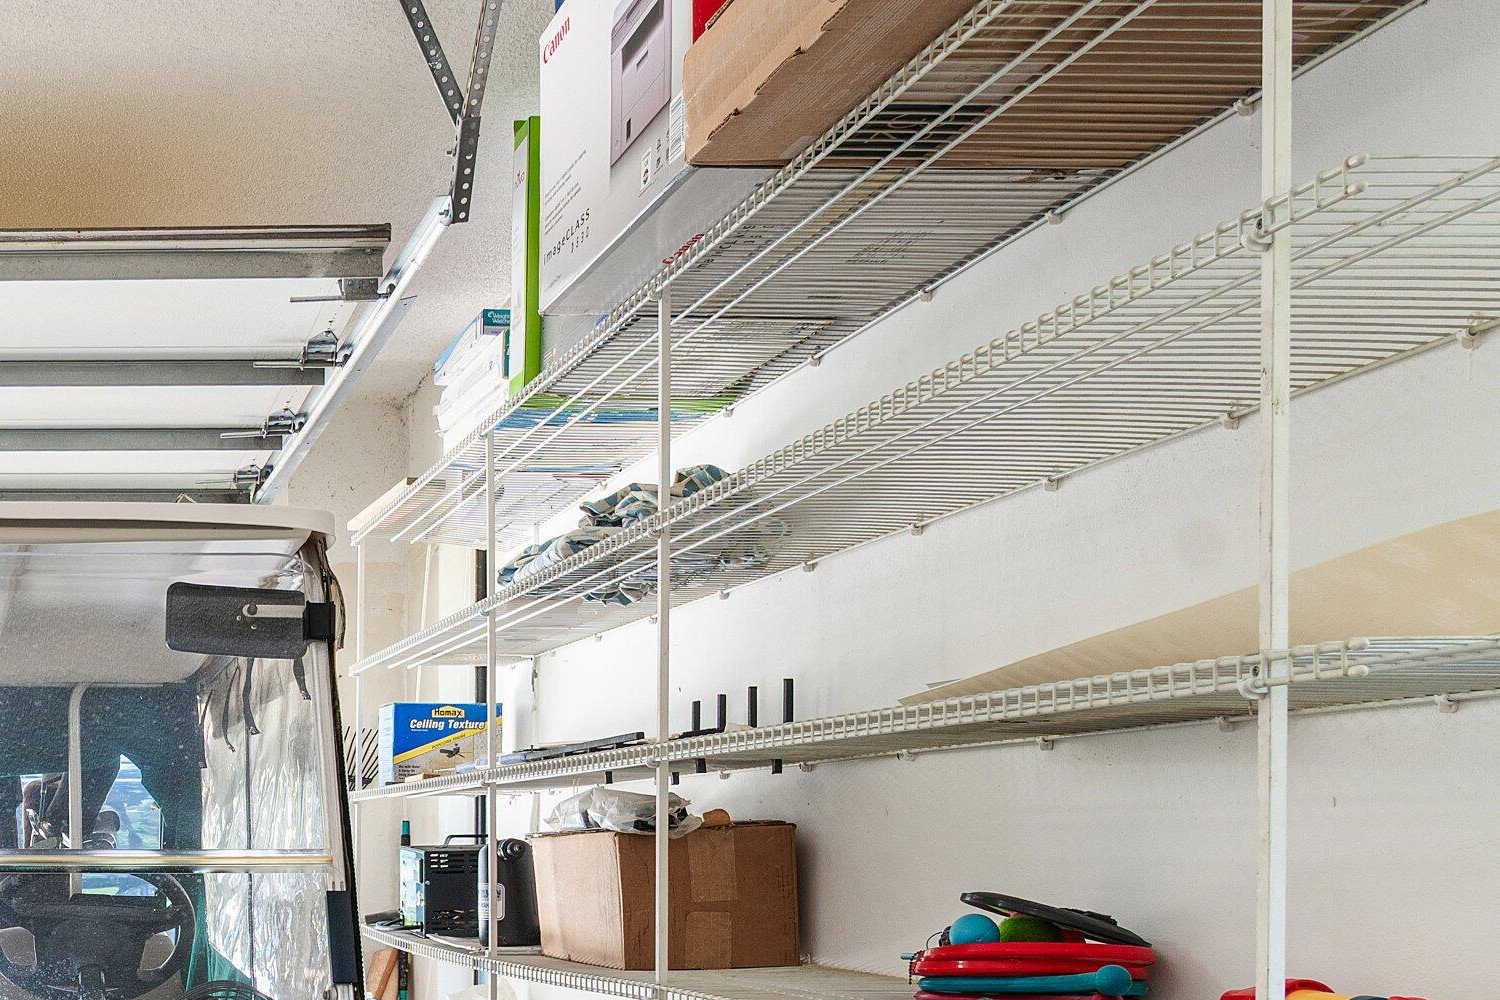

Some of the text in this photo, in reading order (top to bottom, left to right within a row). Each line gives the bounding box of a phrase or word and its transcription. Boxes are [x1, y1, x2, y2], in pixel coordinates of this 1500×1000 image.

[543, 16, 571, 64] Canon
[543, 208, 591, 266] imageCLASS
[410, 719, 485, 730] Ceiling Texture
[434, 706, 463, 718] Homax
